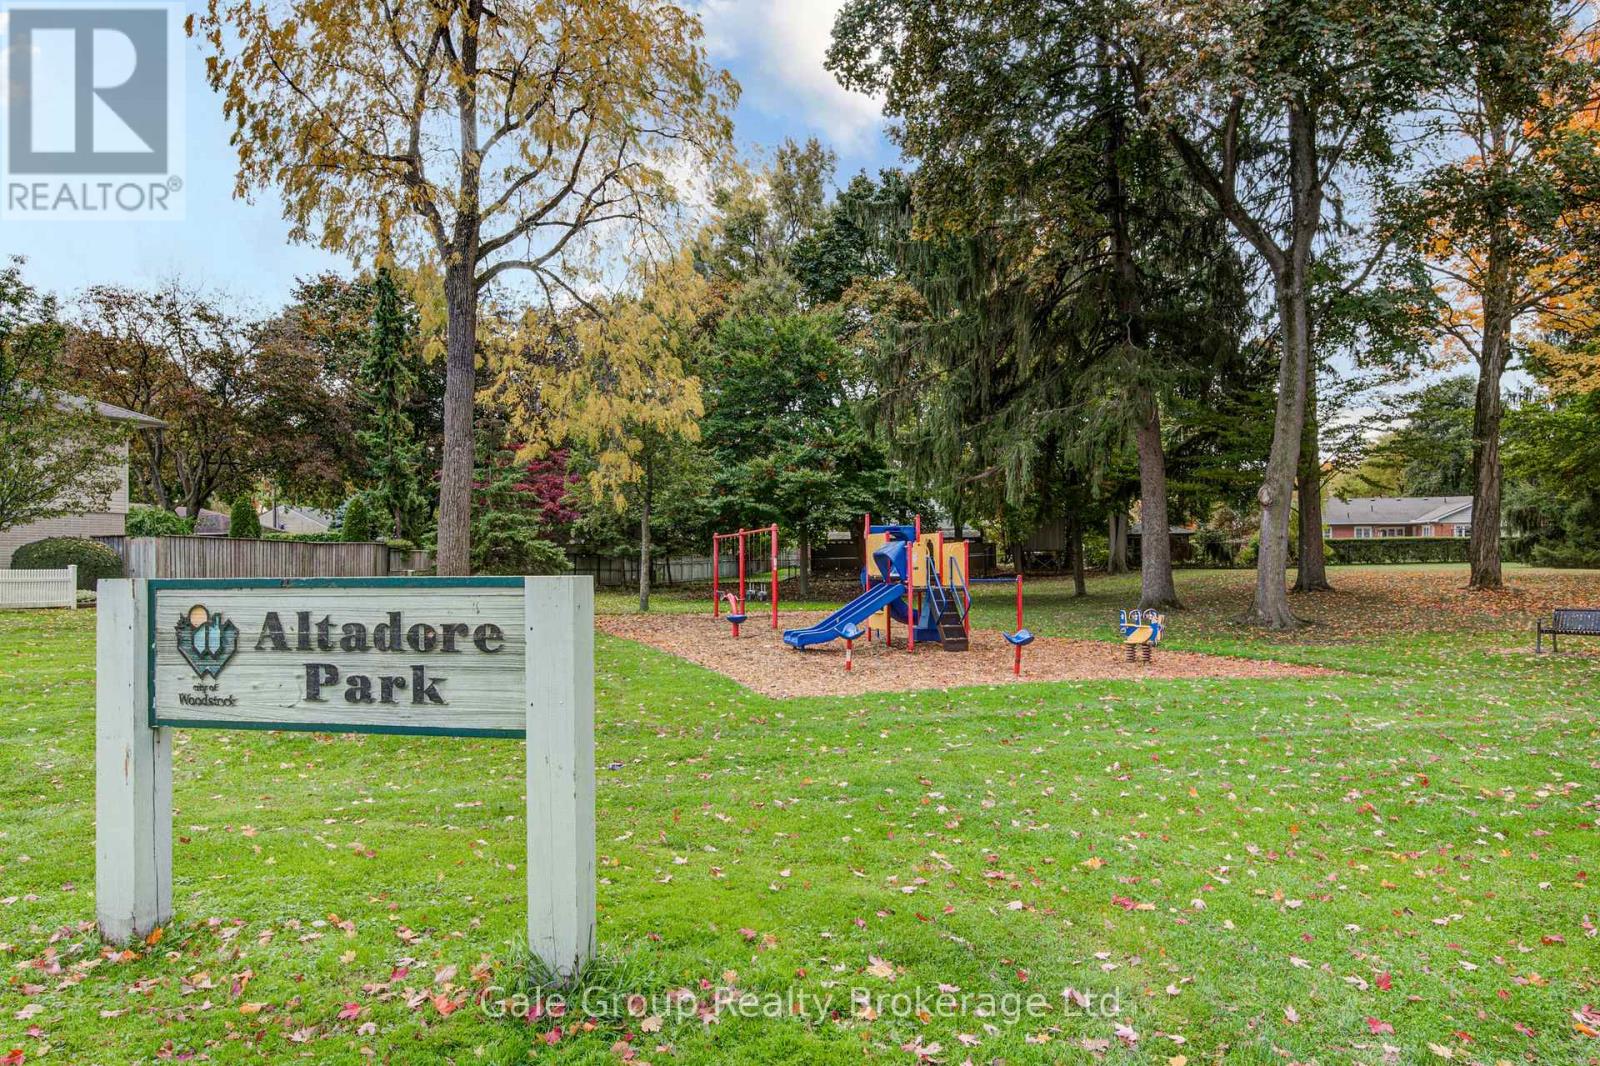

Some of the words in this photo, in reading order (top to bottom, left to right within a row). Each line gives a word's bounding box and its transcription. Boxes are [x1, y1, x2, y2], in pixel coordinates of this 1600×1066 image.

[254, 610, 505, 653] Altadore
[179, 693, 239, 706] Woodstock
[302, 662, 449, 706] Park
